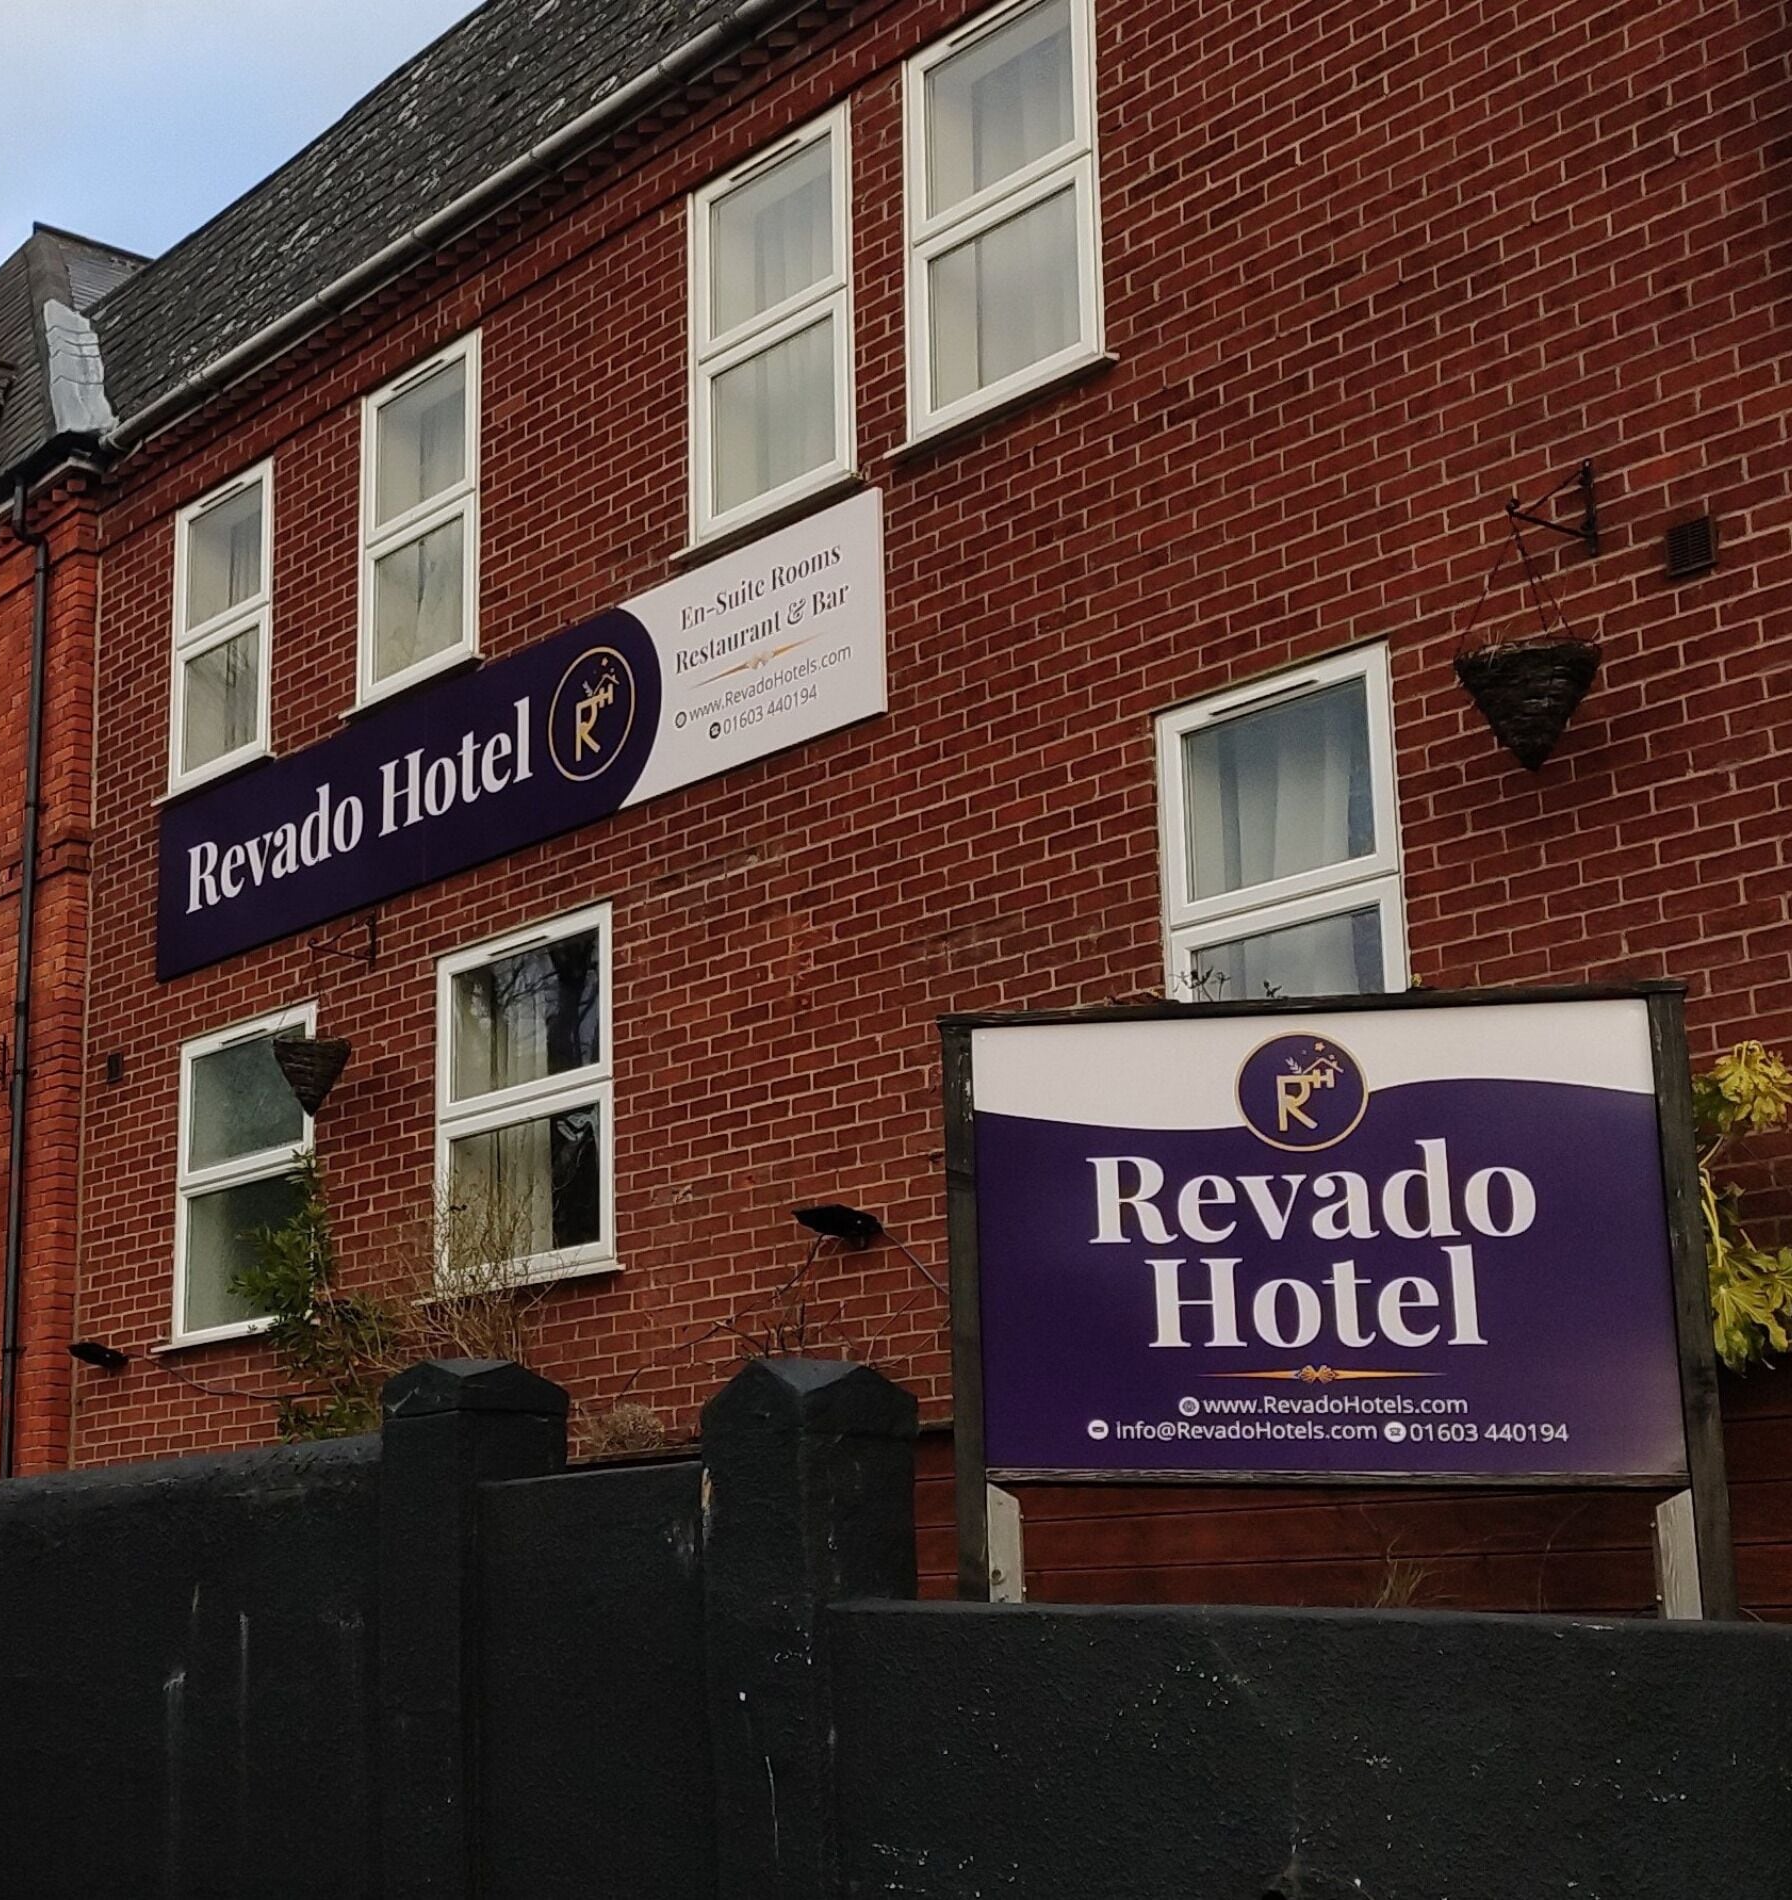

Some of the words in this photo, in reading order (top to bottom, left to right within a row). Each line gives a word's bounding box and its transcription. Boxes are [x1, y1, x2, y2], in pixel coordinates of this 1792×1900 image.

[675, 611, 781, 674] Restaurant
[787, 599, 807, 625] &
[811, 585, 850, 617] Bar
[681, 578, 765, 631] En-Suite
[770, 544, 841, 591] Rooms
[689, 646, 852, 721] www.RevadoHotels.com
[722, 706, 764, 734] 01603
[767, 684, 818, 716] 440194
[185, 784, 364, 914] Revado
[378, 696, 534, 839] Hotel
[1085, 1138, 1537, 1245] Revado
[1143, 1245, 1489, 1349] Hotel
[1203, 1395, 1468, 1415] www.RevadoHotels.com
[1410, 1423, 1478, 1443] 01603
[1484, 1423, 1569, 1444] 440194
